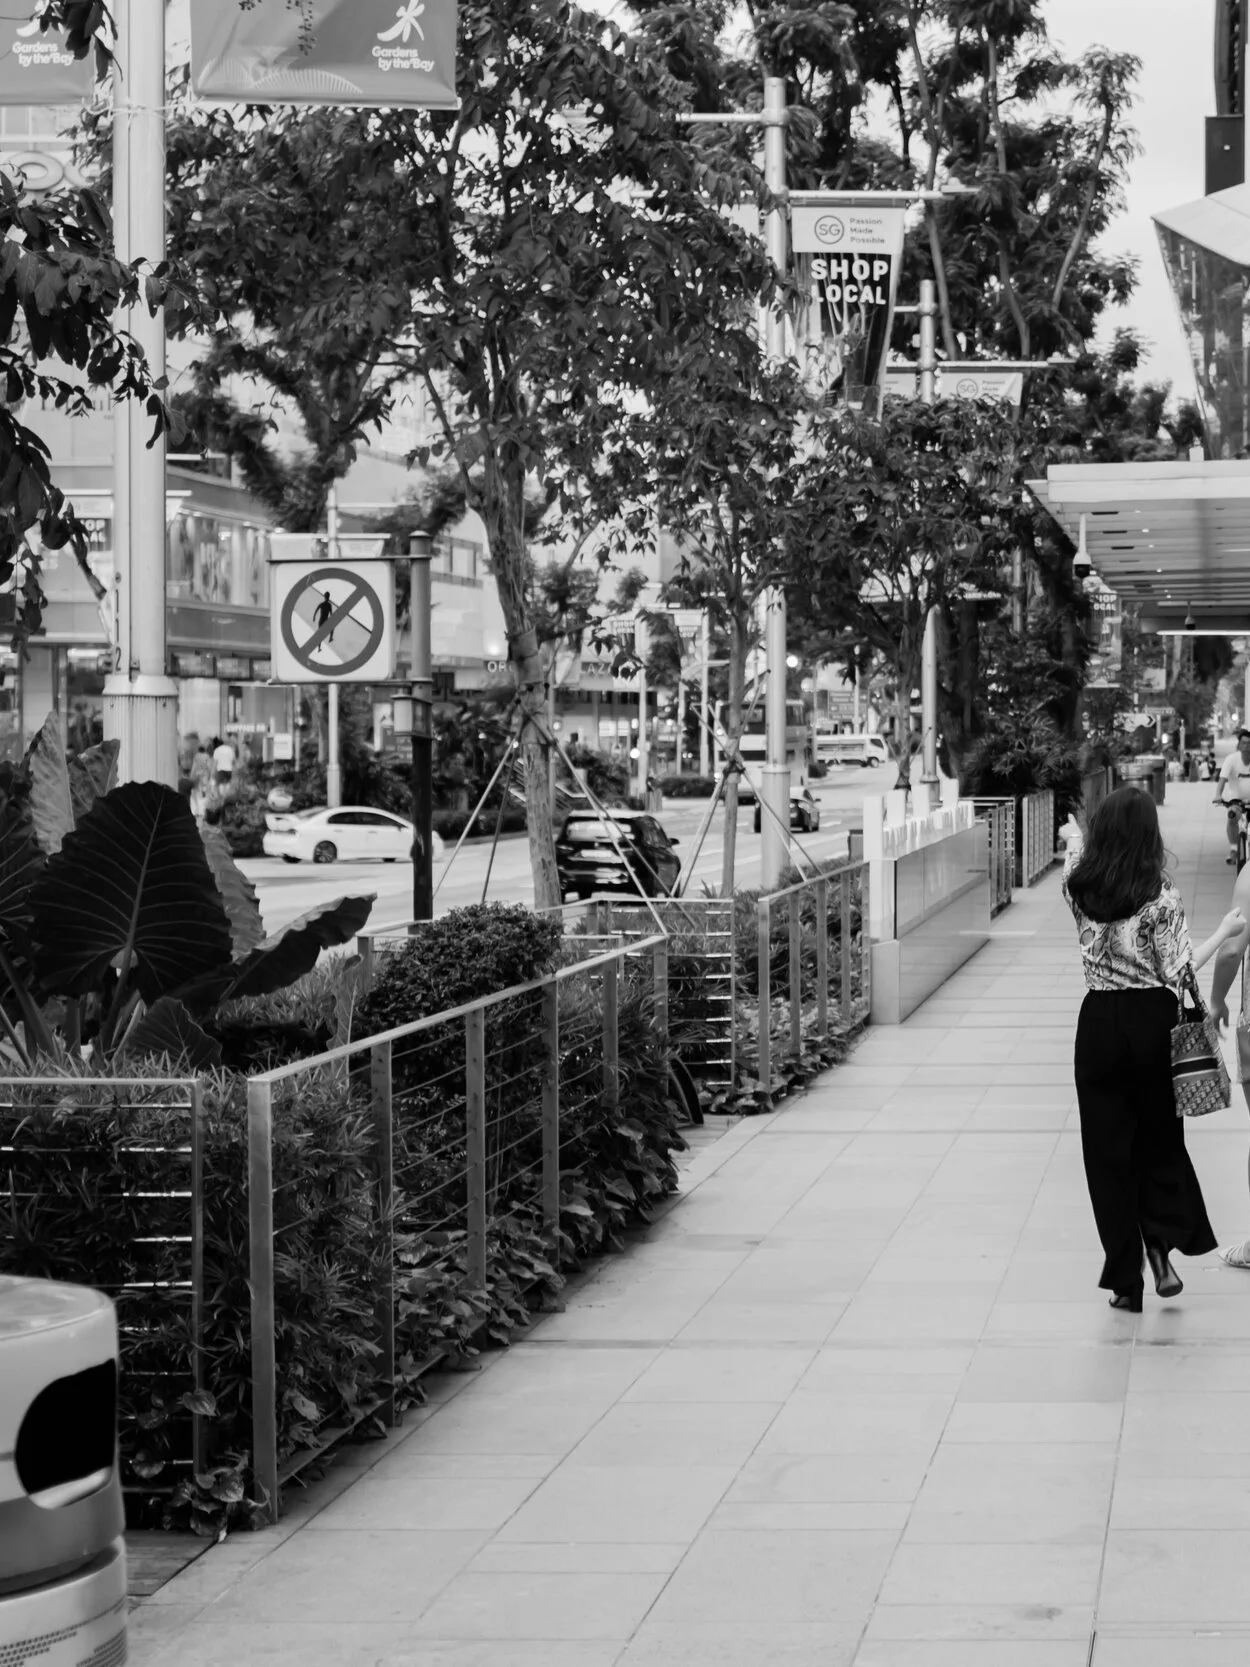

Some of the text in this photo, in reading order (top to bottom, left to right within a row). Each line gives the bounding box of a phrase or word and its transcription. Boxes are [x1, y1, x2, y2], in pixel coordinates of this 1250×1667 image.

[12, 41, 58, 54] Gardens
[371, 46, 418, 57] Gardens
[18, 53, 32, 67] by
[33, 53, 50, 64] the
[378, 57, 435, 72] by the Bay
[849, 217, 882, 225] Passion
[818, 223, 841, 236] SG
[849, 236, 886, 244] Possible
[810, 258, 889, 281] SHOP
[810, 284, 887, 305] LOCAL
